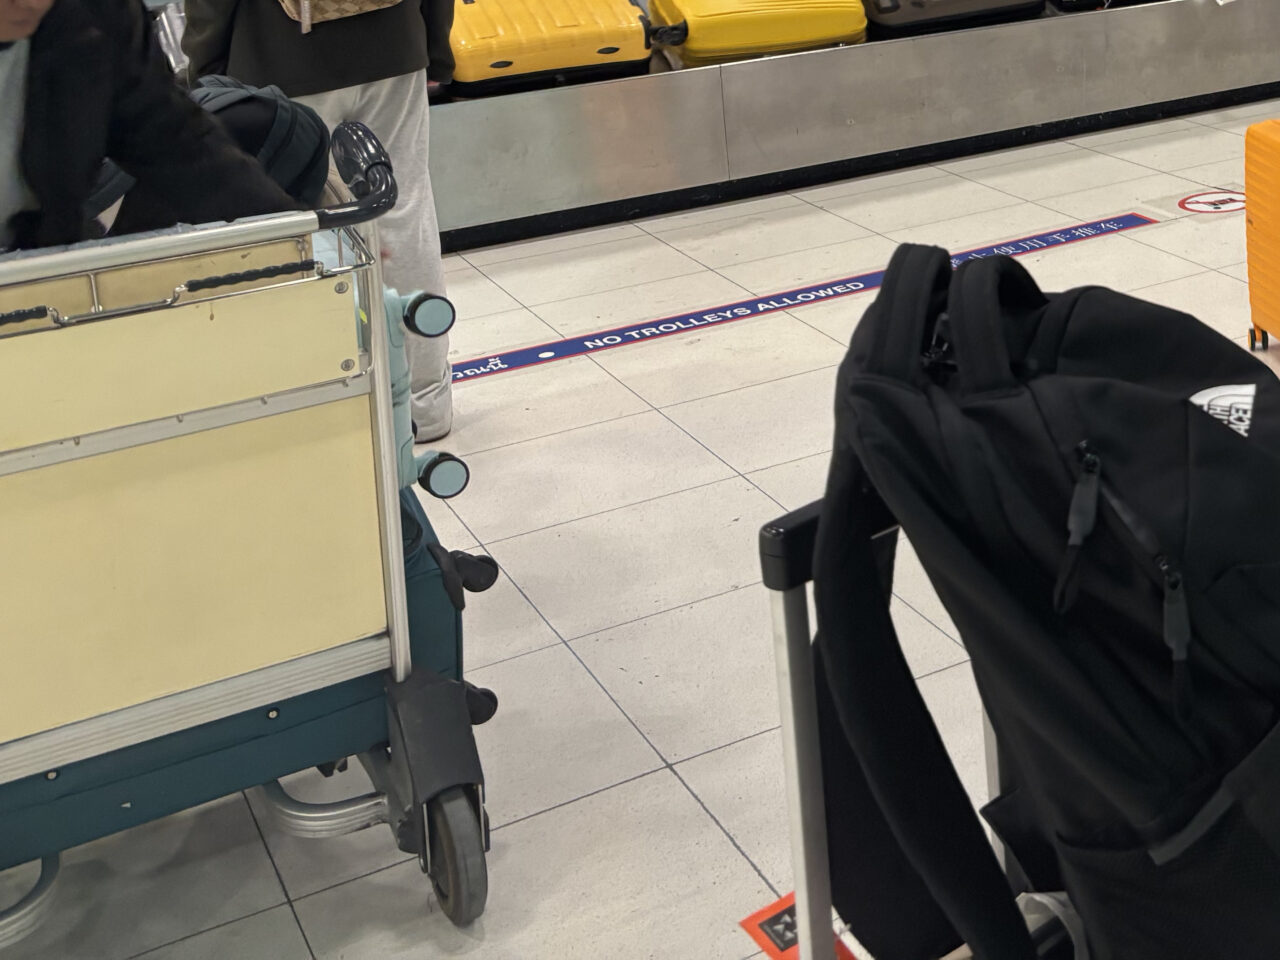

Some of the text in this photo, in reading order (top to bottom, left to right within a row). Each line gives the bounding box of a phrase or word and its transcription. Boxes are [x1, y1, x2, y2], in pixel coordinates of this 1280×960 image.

[584, 280, 866, 349] NO TROLLEYS ALLOWED
